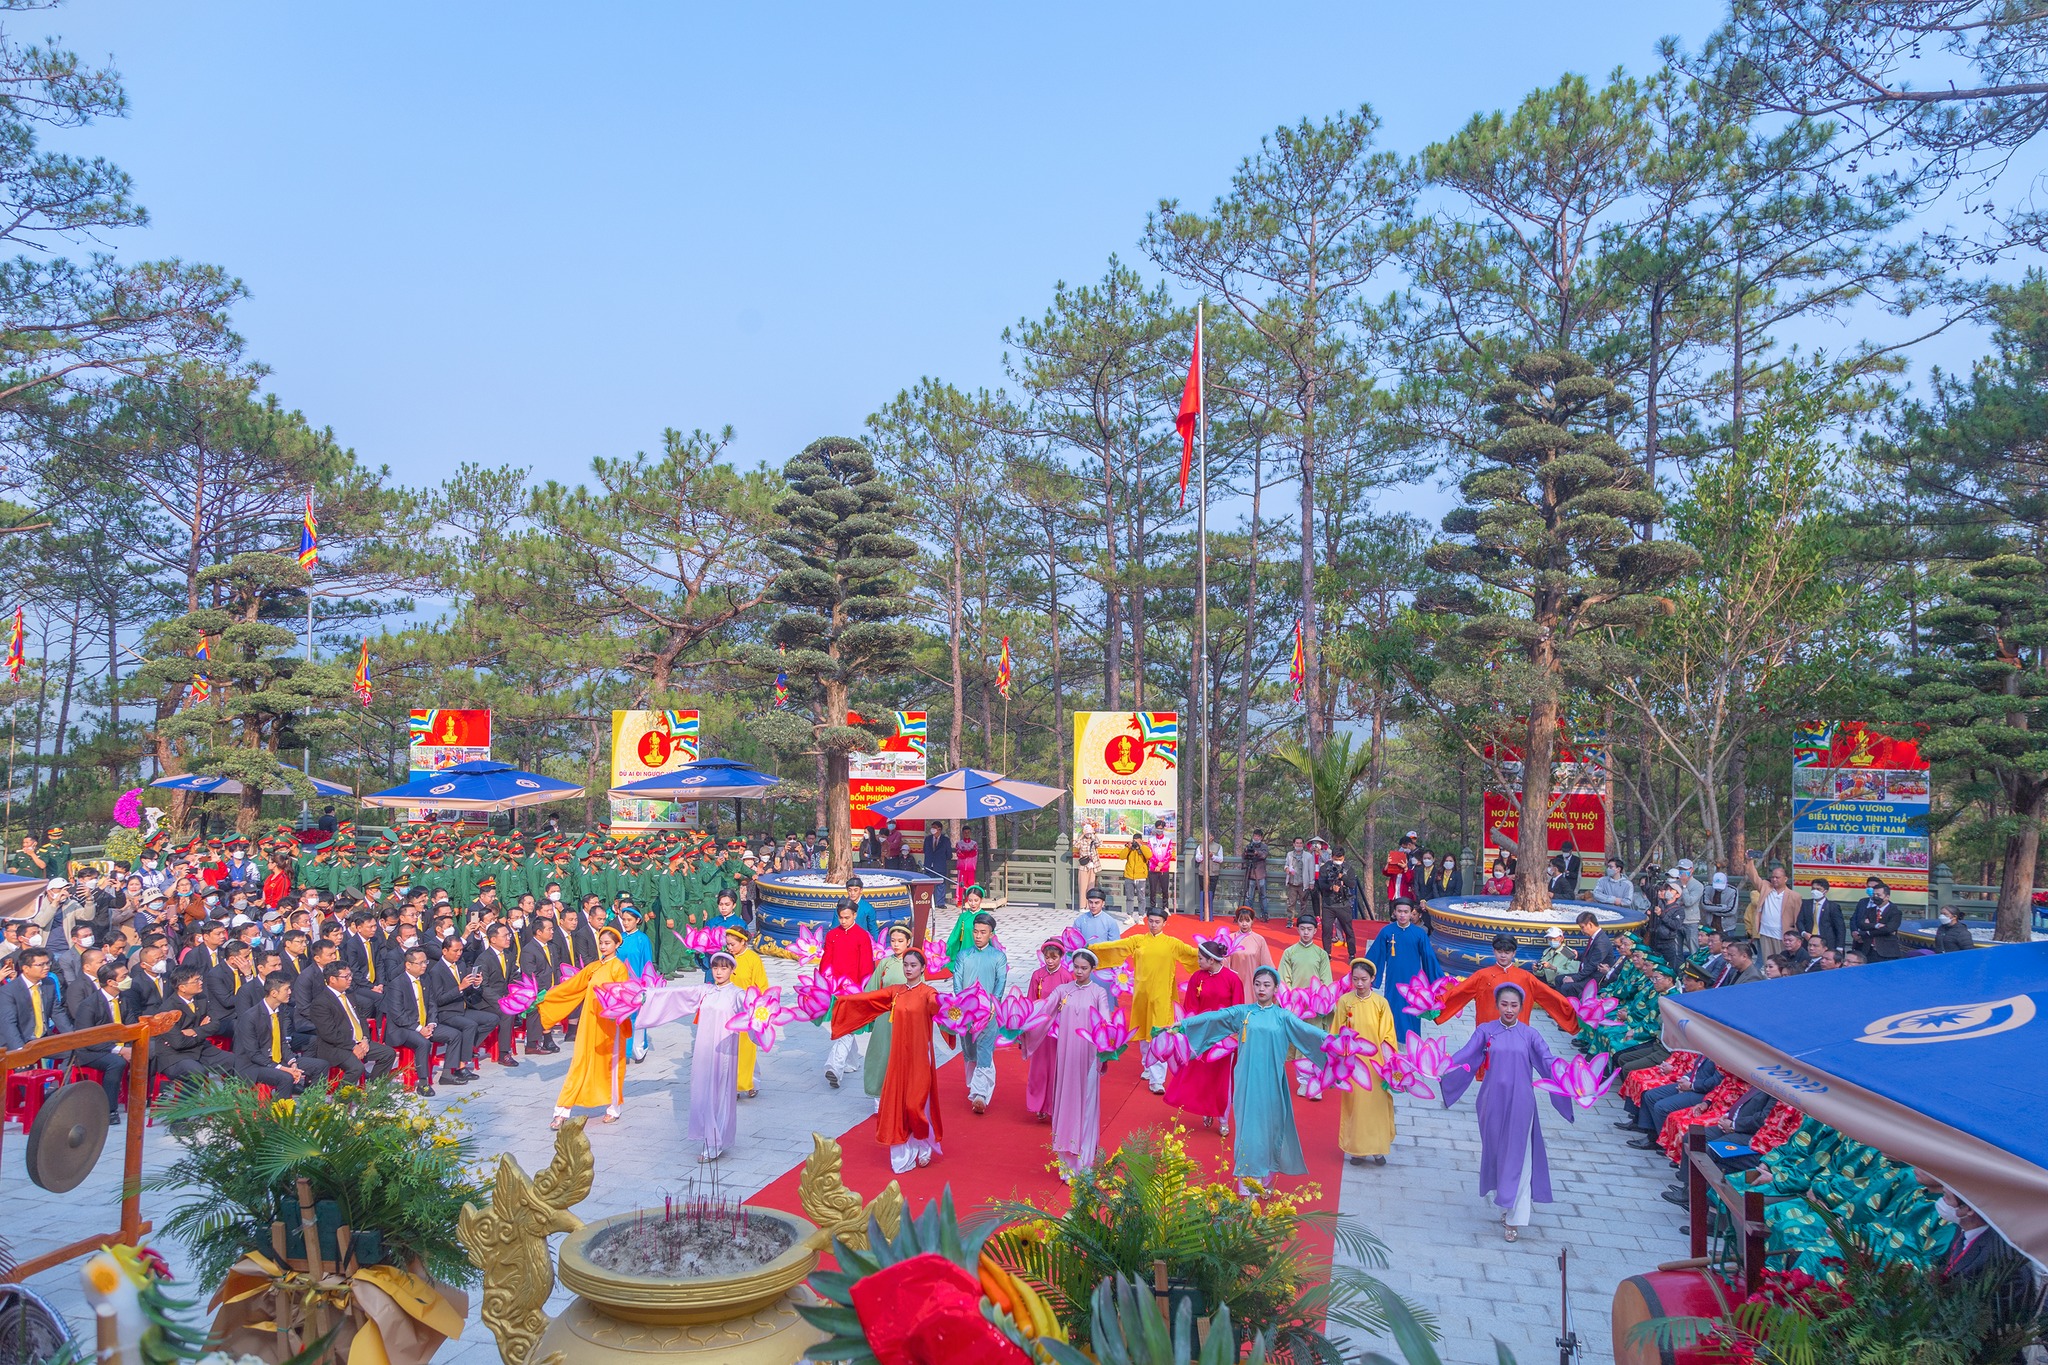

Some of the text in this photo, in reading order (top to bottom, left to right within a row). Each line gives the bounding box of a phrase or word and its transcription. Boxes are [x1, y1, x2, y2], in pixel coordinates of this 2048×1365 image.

[1082, 777, 1092, 785] DÙ
[1149, 779, 1167, 787] XUÔI
[860, 783, 895, 792] ĐỀN HÙNG
[1110, 788, 1130, 796] NGÀY
[1128, 798, 1152, 806] THÁNG
[1829, 802, 1894, 813] HÙNG VƯƠNG
[1569, 812, 1580, 821] TỤ
[1581, 811, 1598, 822] HỘI
[1808, 810, 1910, 824] BIỂU TƯỢNG TINH THẦ
[1576, 821, 1595, 831] THỜ
[1816, 821, 1906, 835] DÂN TỘC VIỆT NAM
